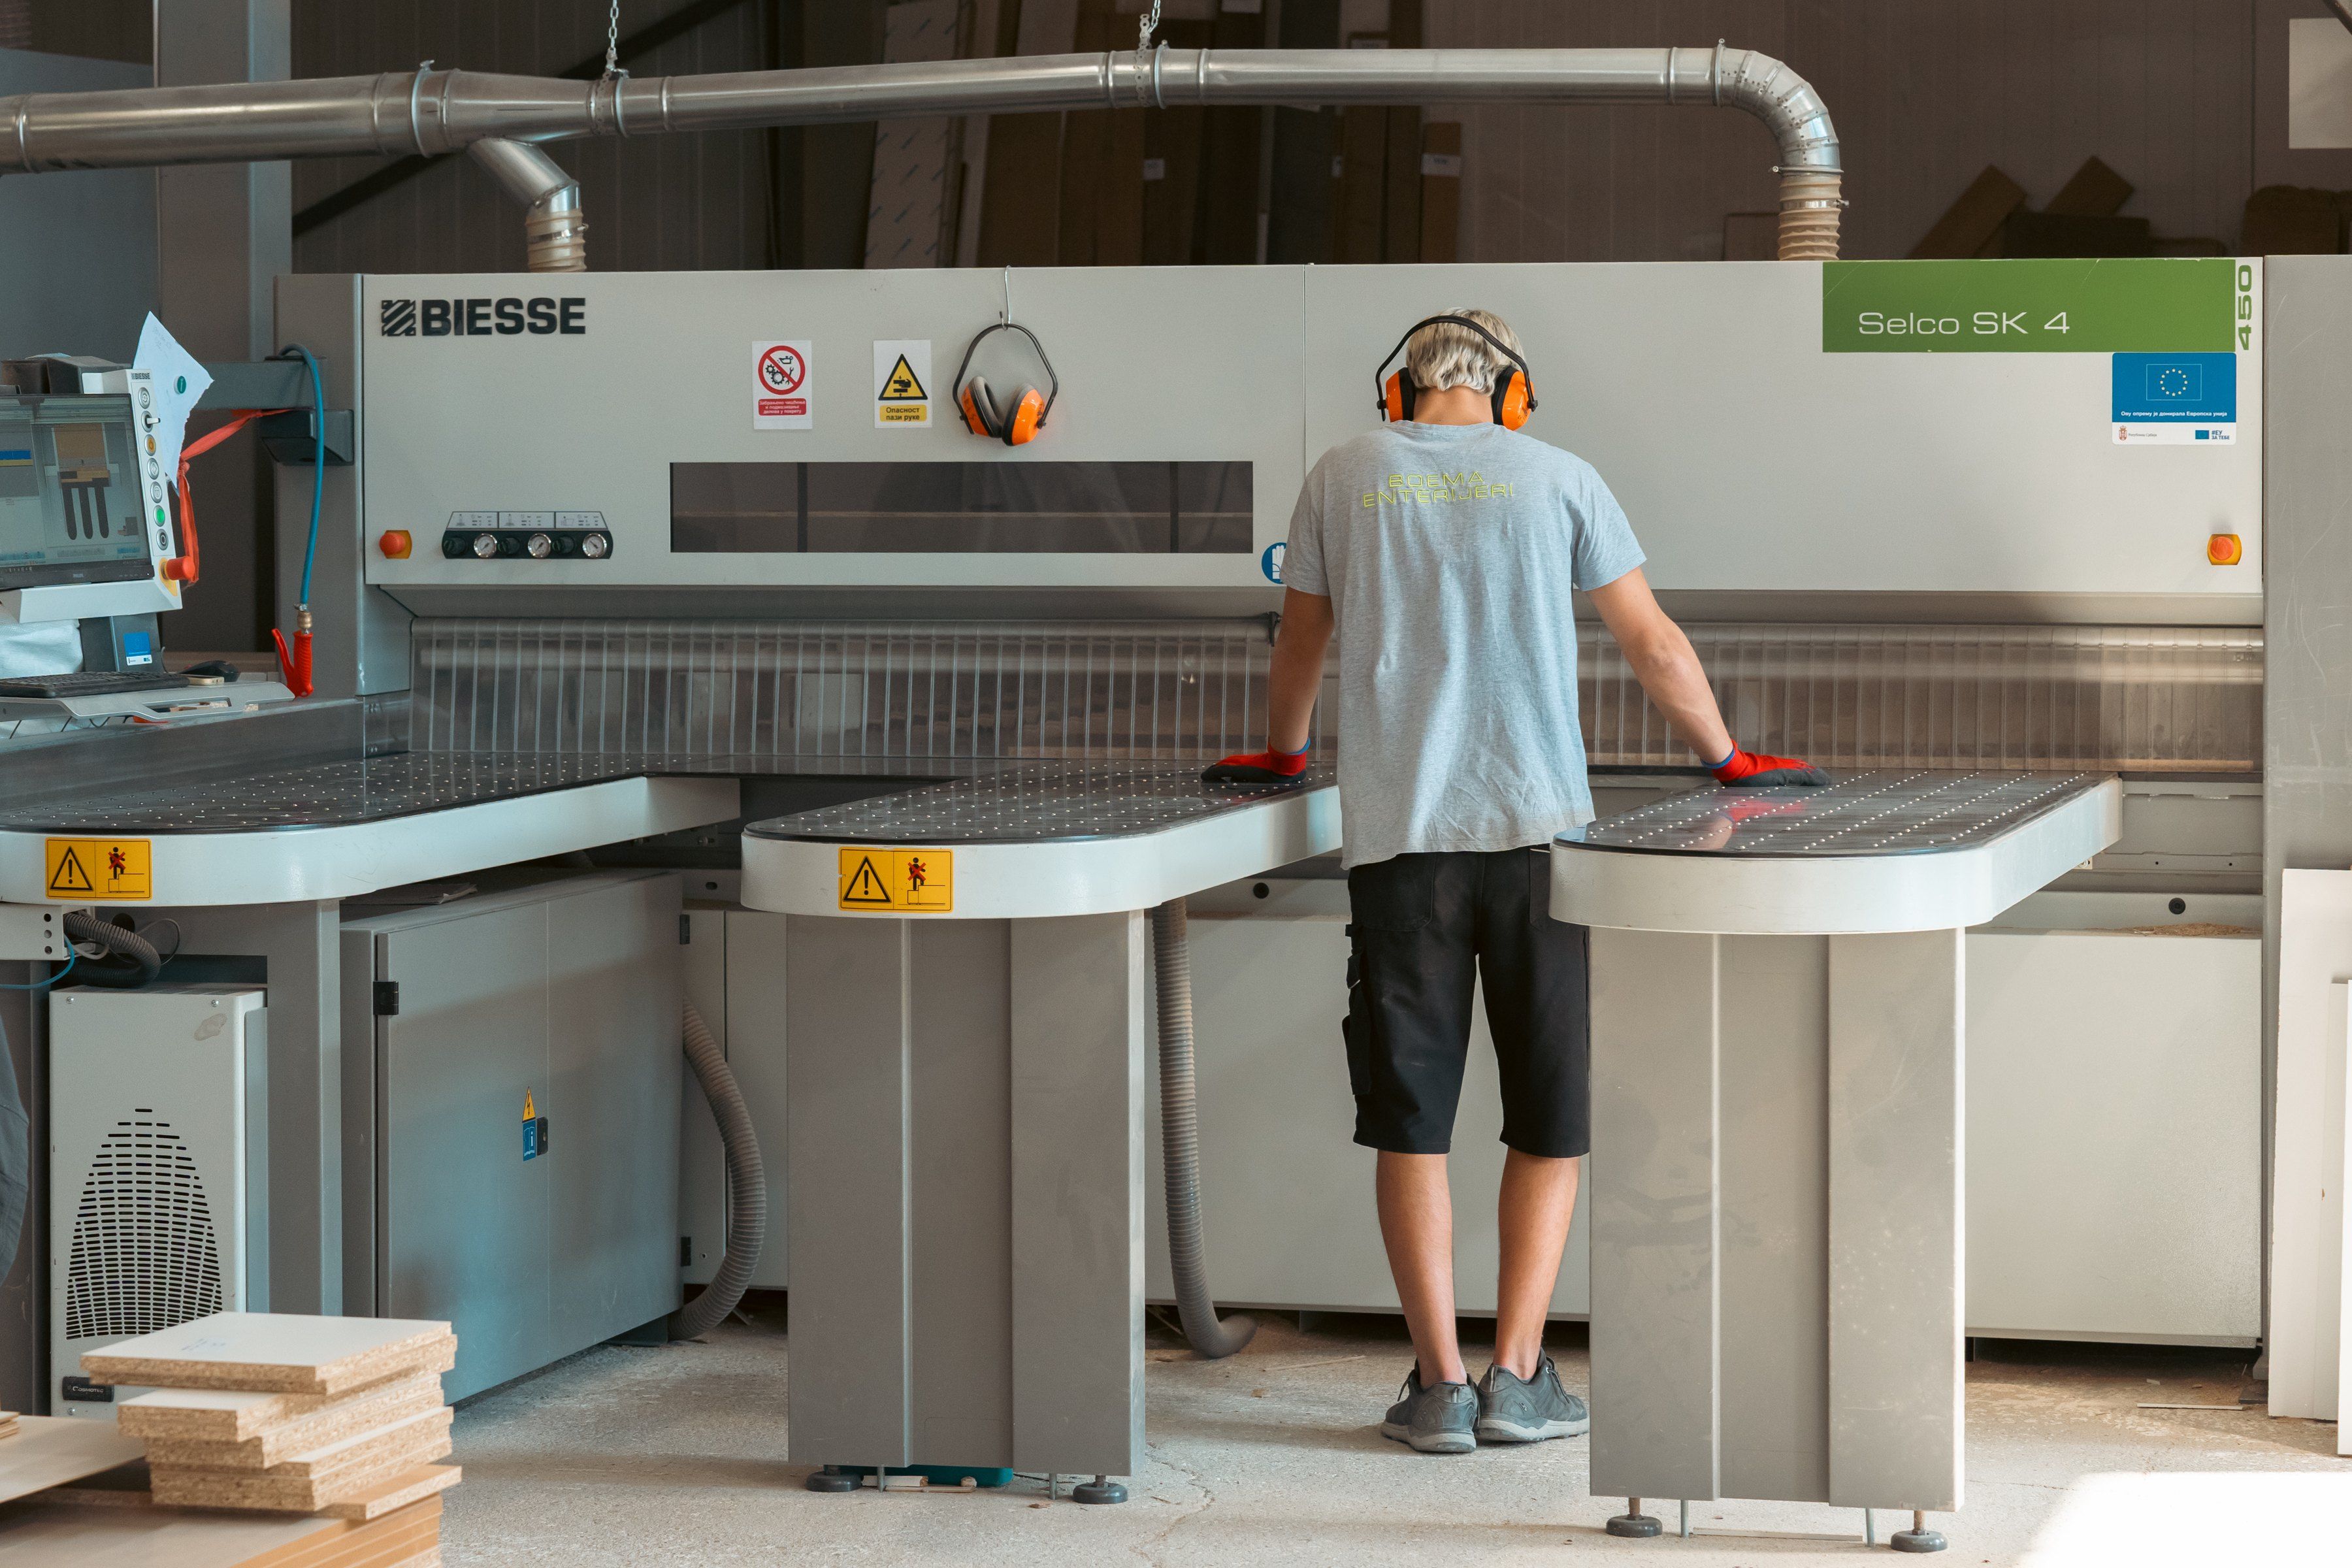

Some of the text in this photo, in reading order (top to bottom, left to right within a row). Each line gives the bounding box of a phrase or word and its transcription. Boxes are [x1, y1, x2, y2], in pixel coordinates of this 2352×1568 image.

[421, 297, 586, 336] BIESSE
[2238, 265, 2252, 351] 450
[1859, 312, 2070, 335] Selco SK 4
[1388, 470, 1484, 488] BOEMA
[1363, 483, 1514, 508] ENTERIJERI
